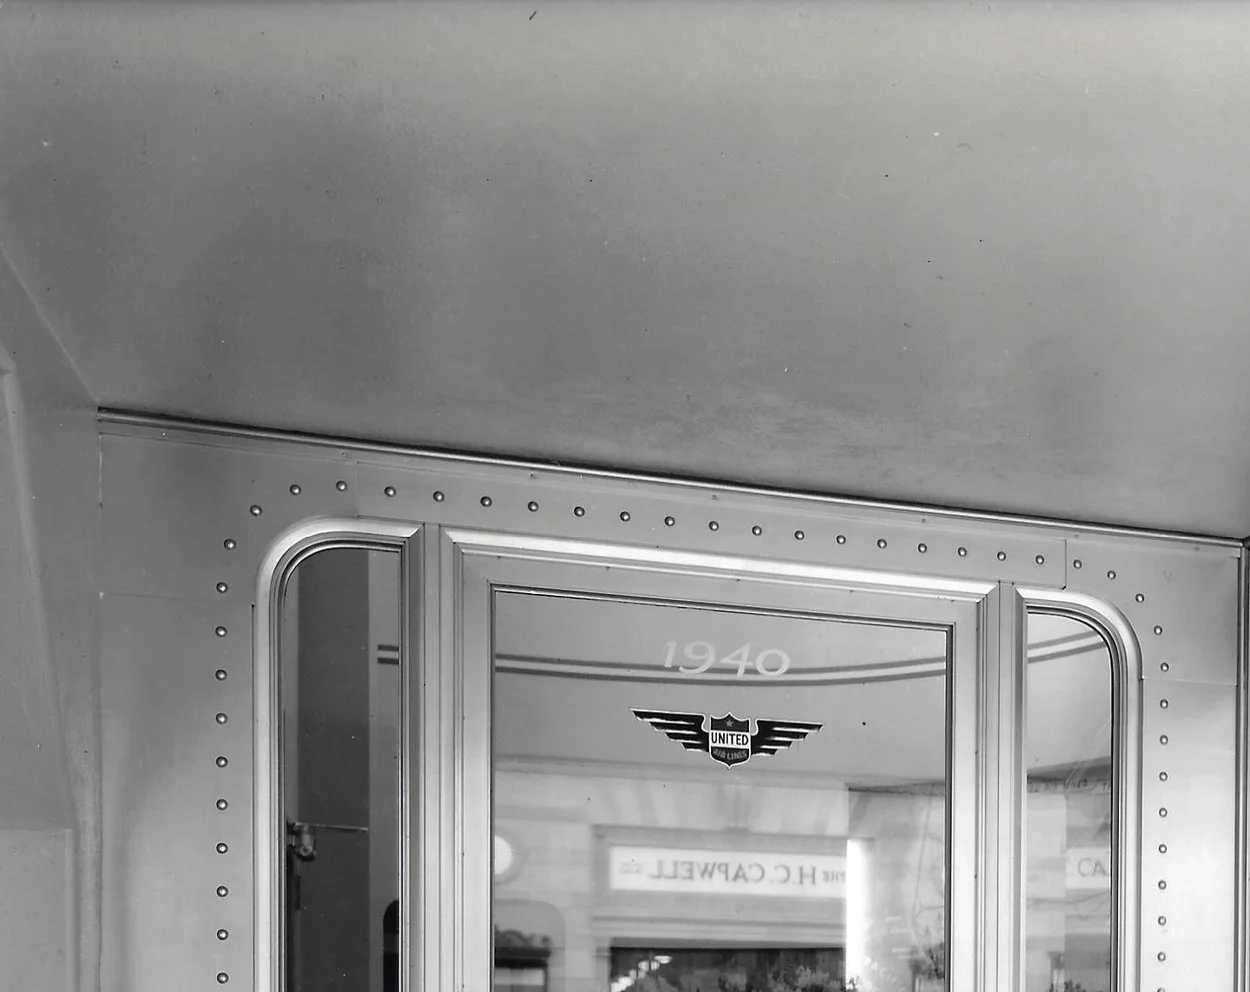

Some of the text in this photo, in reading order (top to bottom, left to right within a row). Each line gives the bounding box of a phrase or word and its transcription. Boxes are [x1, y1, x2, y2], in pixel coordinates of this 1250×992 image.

[664, 640, 791, 679] 1940
[711, 732, 749, 746] UNITED
[712, 748, 748, 761] AIR LINES
